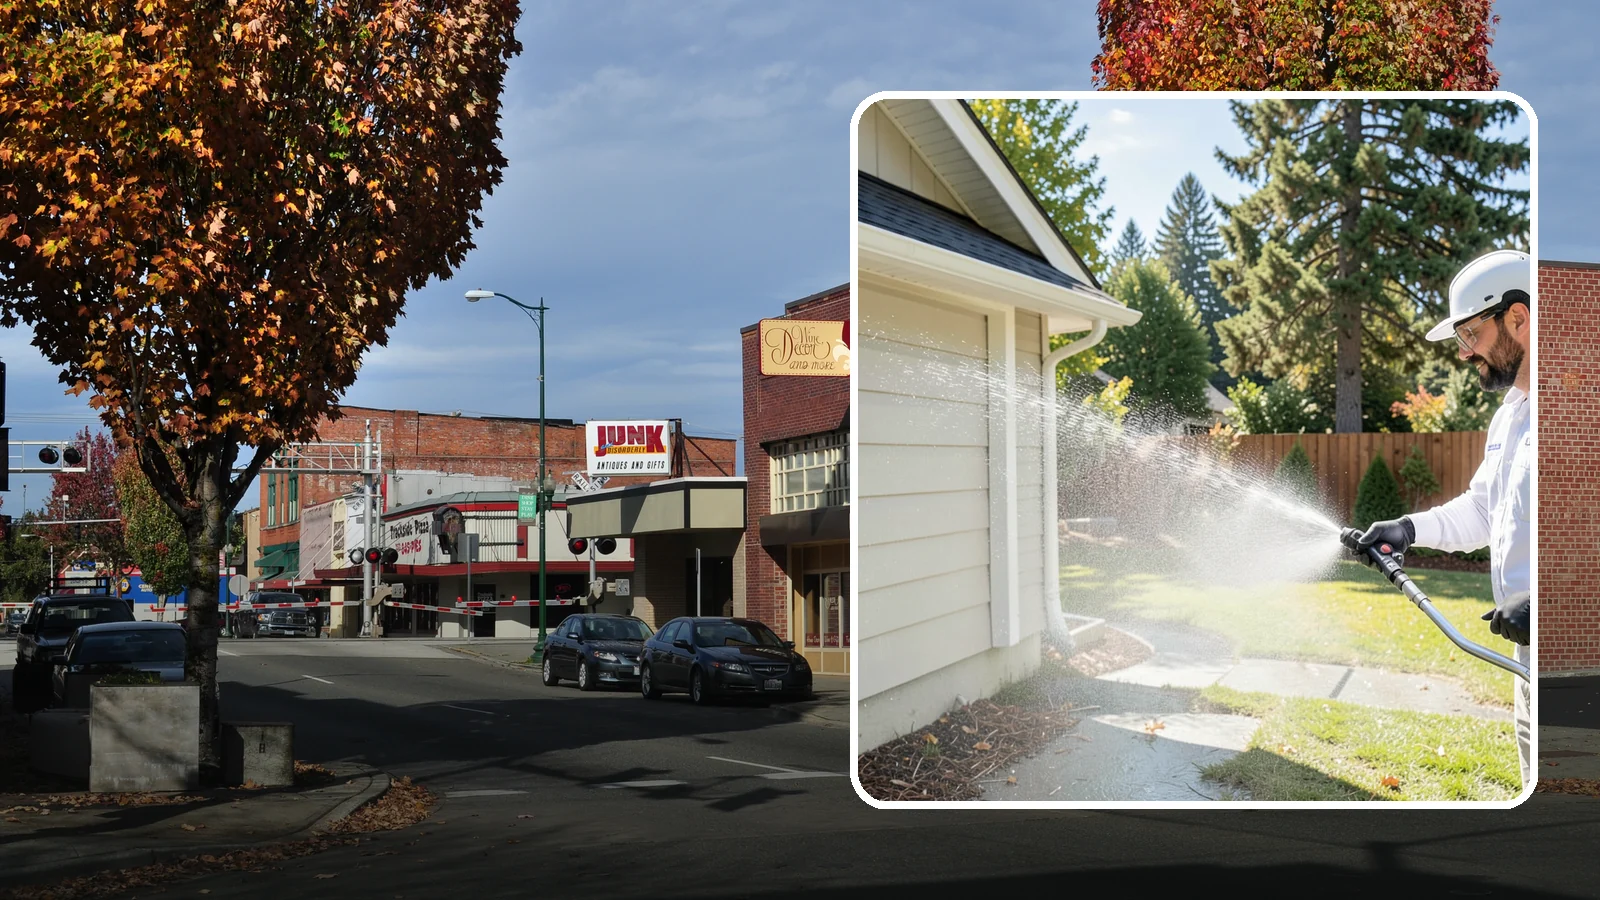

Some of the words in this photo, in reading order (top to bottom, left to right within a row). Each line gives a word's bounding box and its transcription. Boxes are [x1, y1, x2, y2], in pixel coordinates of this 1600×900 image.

[595, 425, 665, 457] JUNK
[607, 446, 645, 454] DISORDERLY
[597, 461, 628, 470] ANTIQUES
[631, 461, 644, 469] AND
[647, 460, 665, 469] GIFTS
[352, 499, 365, 510] CRO
[415, 520, 429, 535] Pizza
